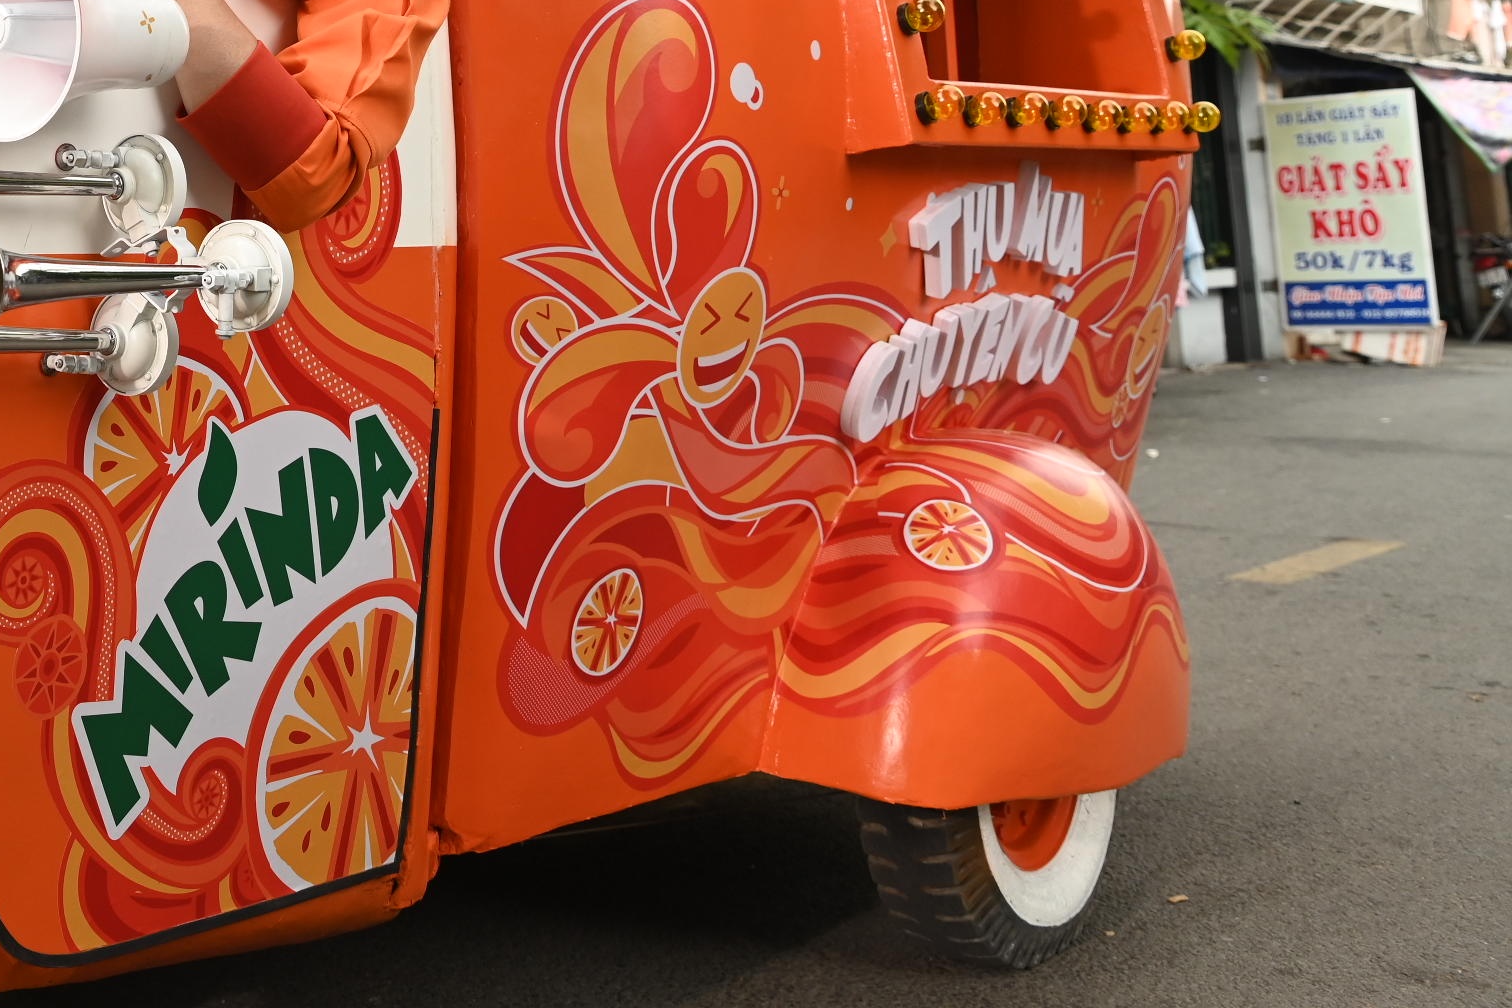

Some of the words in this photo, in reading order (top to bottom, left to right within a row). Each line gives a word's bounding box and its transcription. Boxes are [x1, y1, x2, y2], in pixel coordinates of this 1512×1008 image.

[1277, 155, 1347, 199] GIẶT
[1355, 144, 1413, 191] SẤY
[909, 182, 1015, 299] THU
[1009, 160, 1084, 277] MUA
[1310, 199, 1381, 240] KHÔ
[1294, 249, 1416, 273] 50k/7kg
[79, 412, 414, 828] MIRINDA
